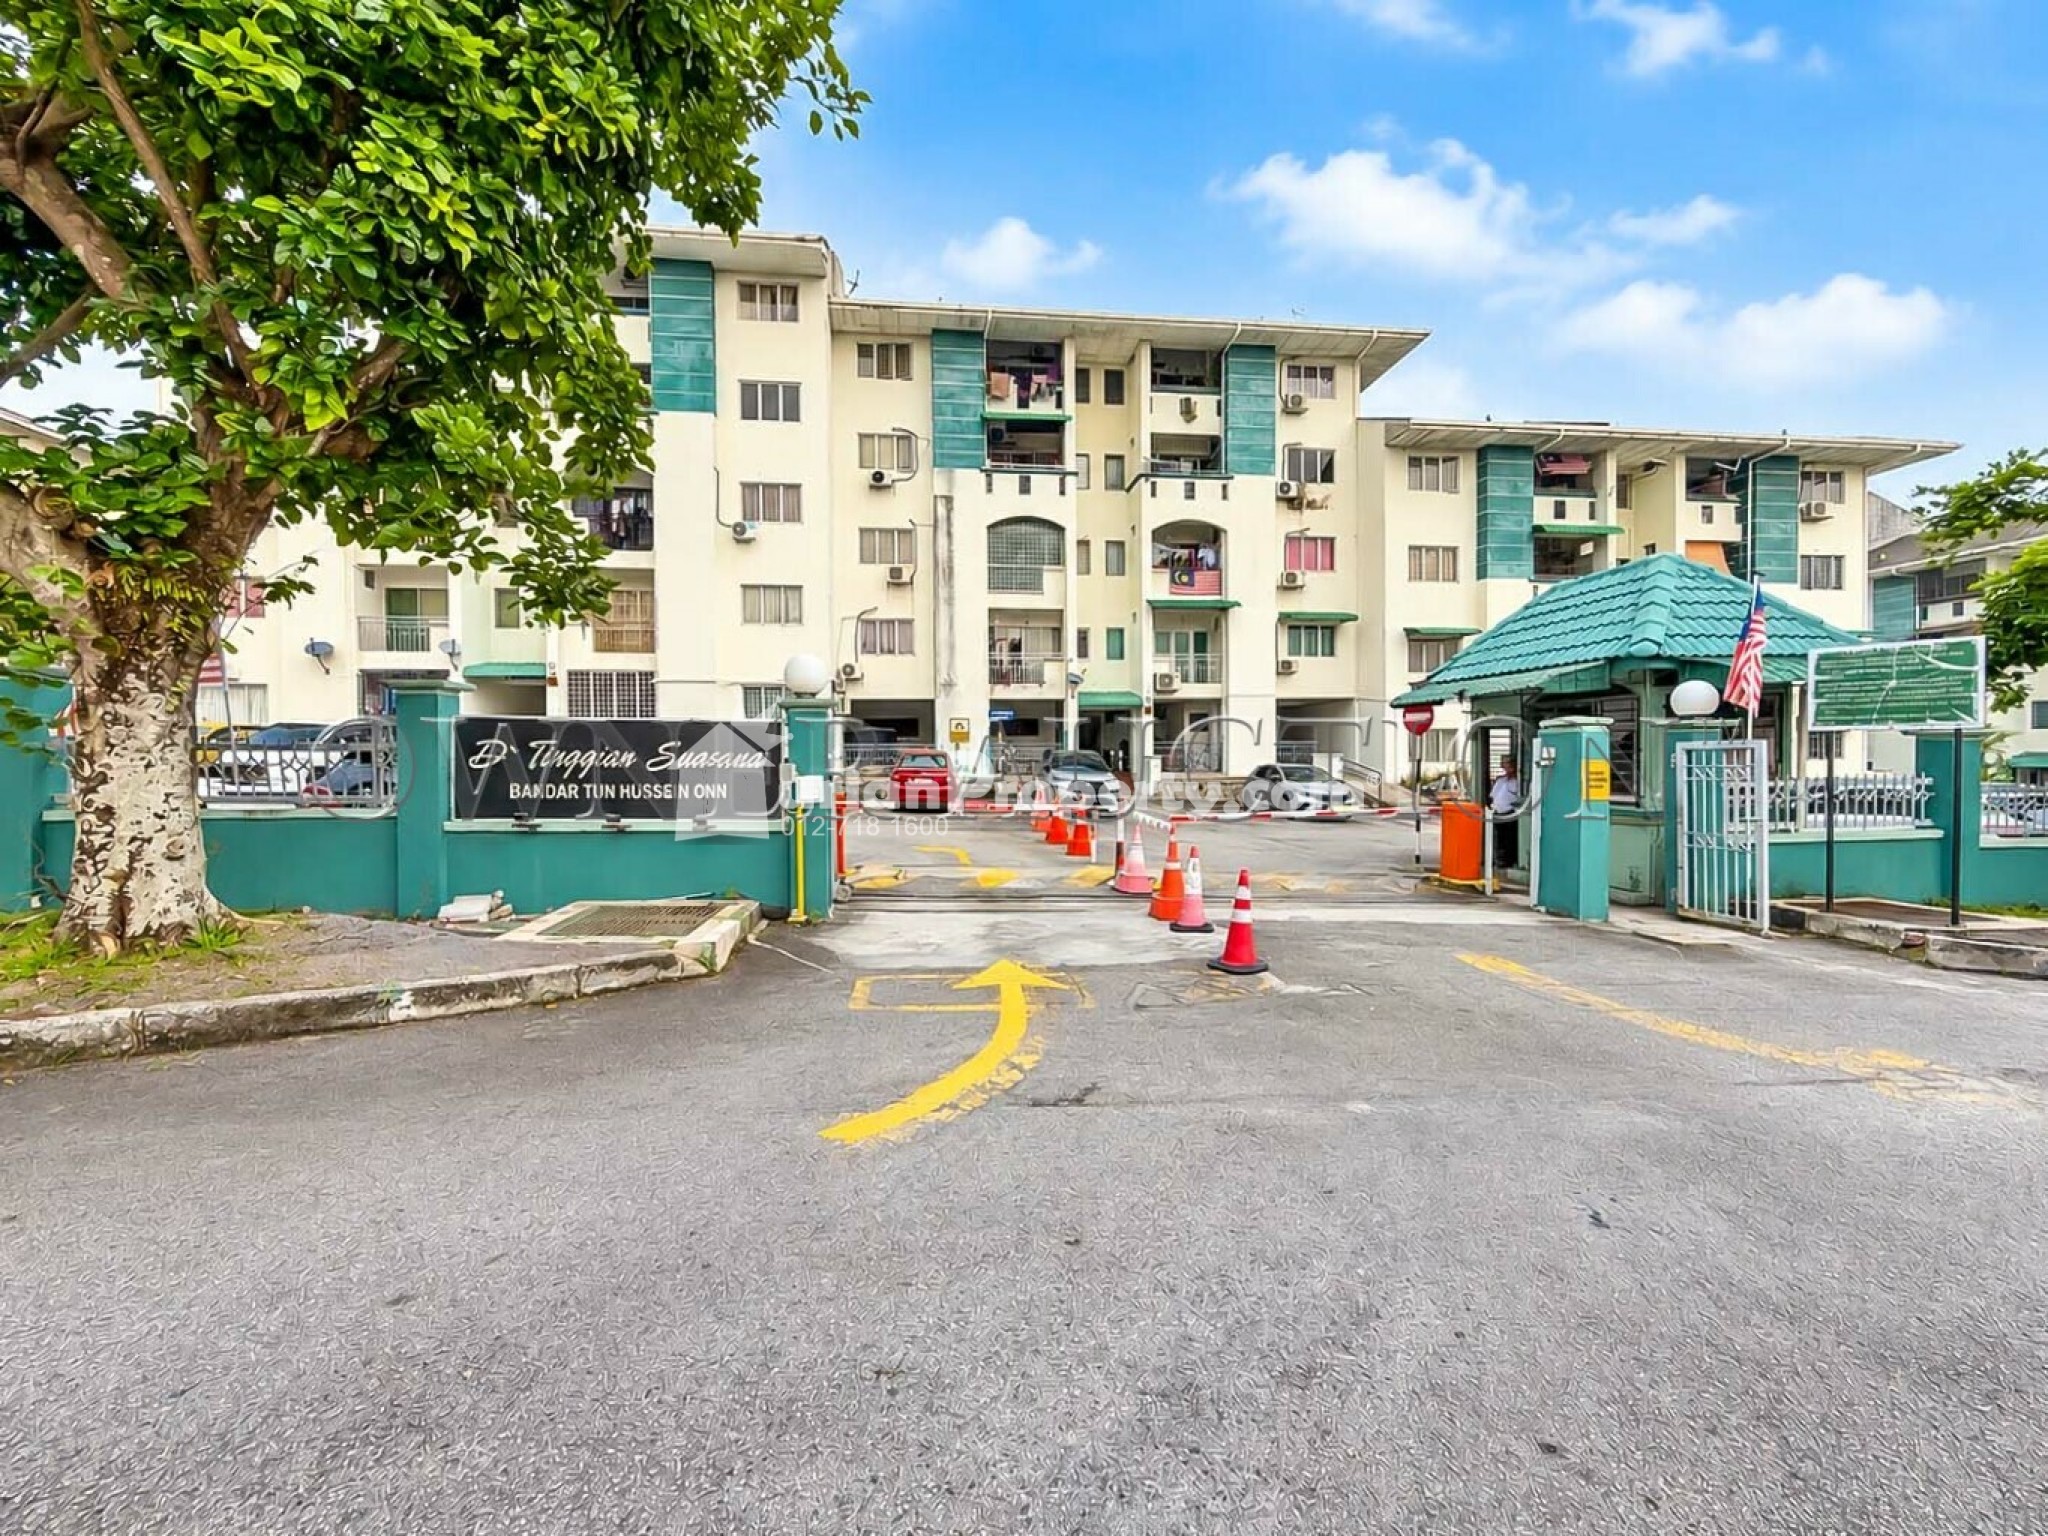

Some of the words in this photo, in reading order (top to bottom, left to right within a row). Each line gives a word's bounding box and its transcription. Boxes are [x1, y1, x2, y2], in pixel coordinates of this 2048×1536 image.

[528, 740, 637, 779] Tinggian
[646, 740, 767, 772] Suasana
[509, 783, 579, 799] BANDAR
[583, 783, 616, 799] TUN
[620, 783, 690, 799] HUSSEN
[694, 783, 728, 799] ONN
